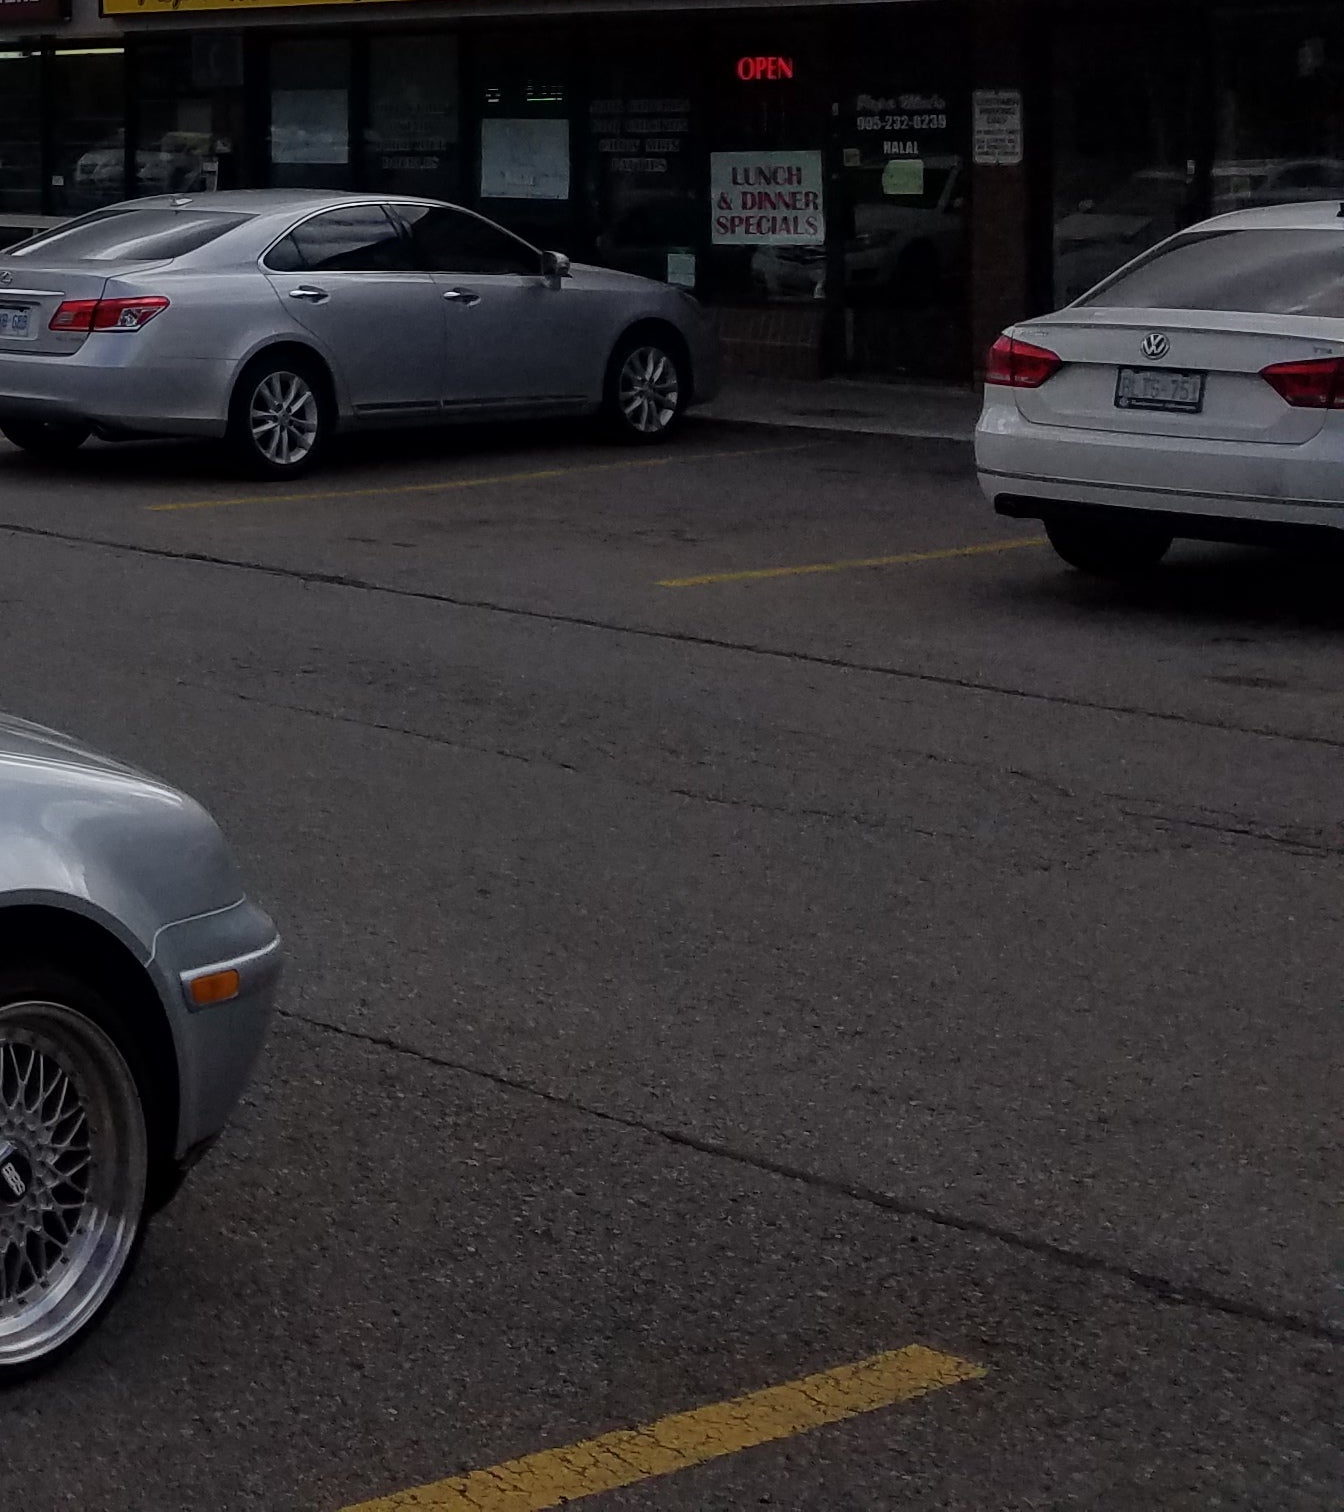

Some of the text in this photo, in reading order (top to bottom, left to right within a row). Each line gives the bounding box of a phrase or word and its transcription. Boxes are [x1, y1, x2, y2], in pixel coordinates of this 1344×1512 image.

[736, 56, 794, 81] OPEN
[883, 141, 919, 155] HALAL
[732, 167, 802, 186] LUNCH
[717, 191, 819, 210] & DINNER
[716, 216, 818, 235] SPECIALS
